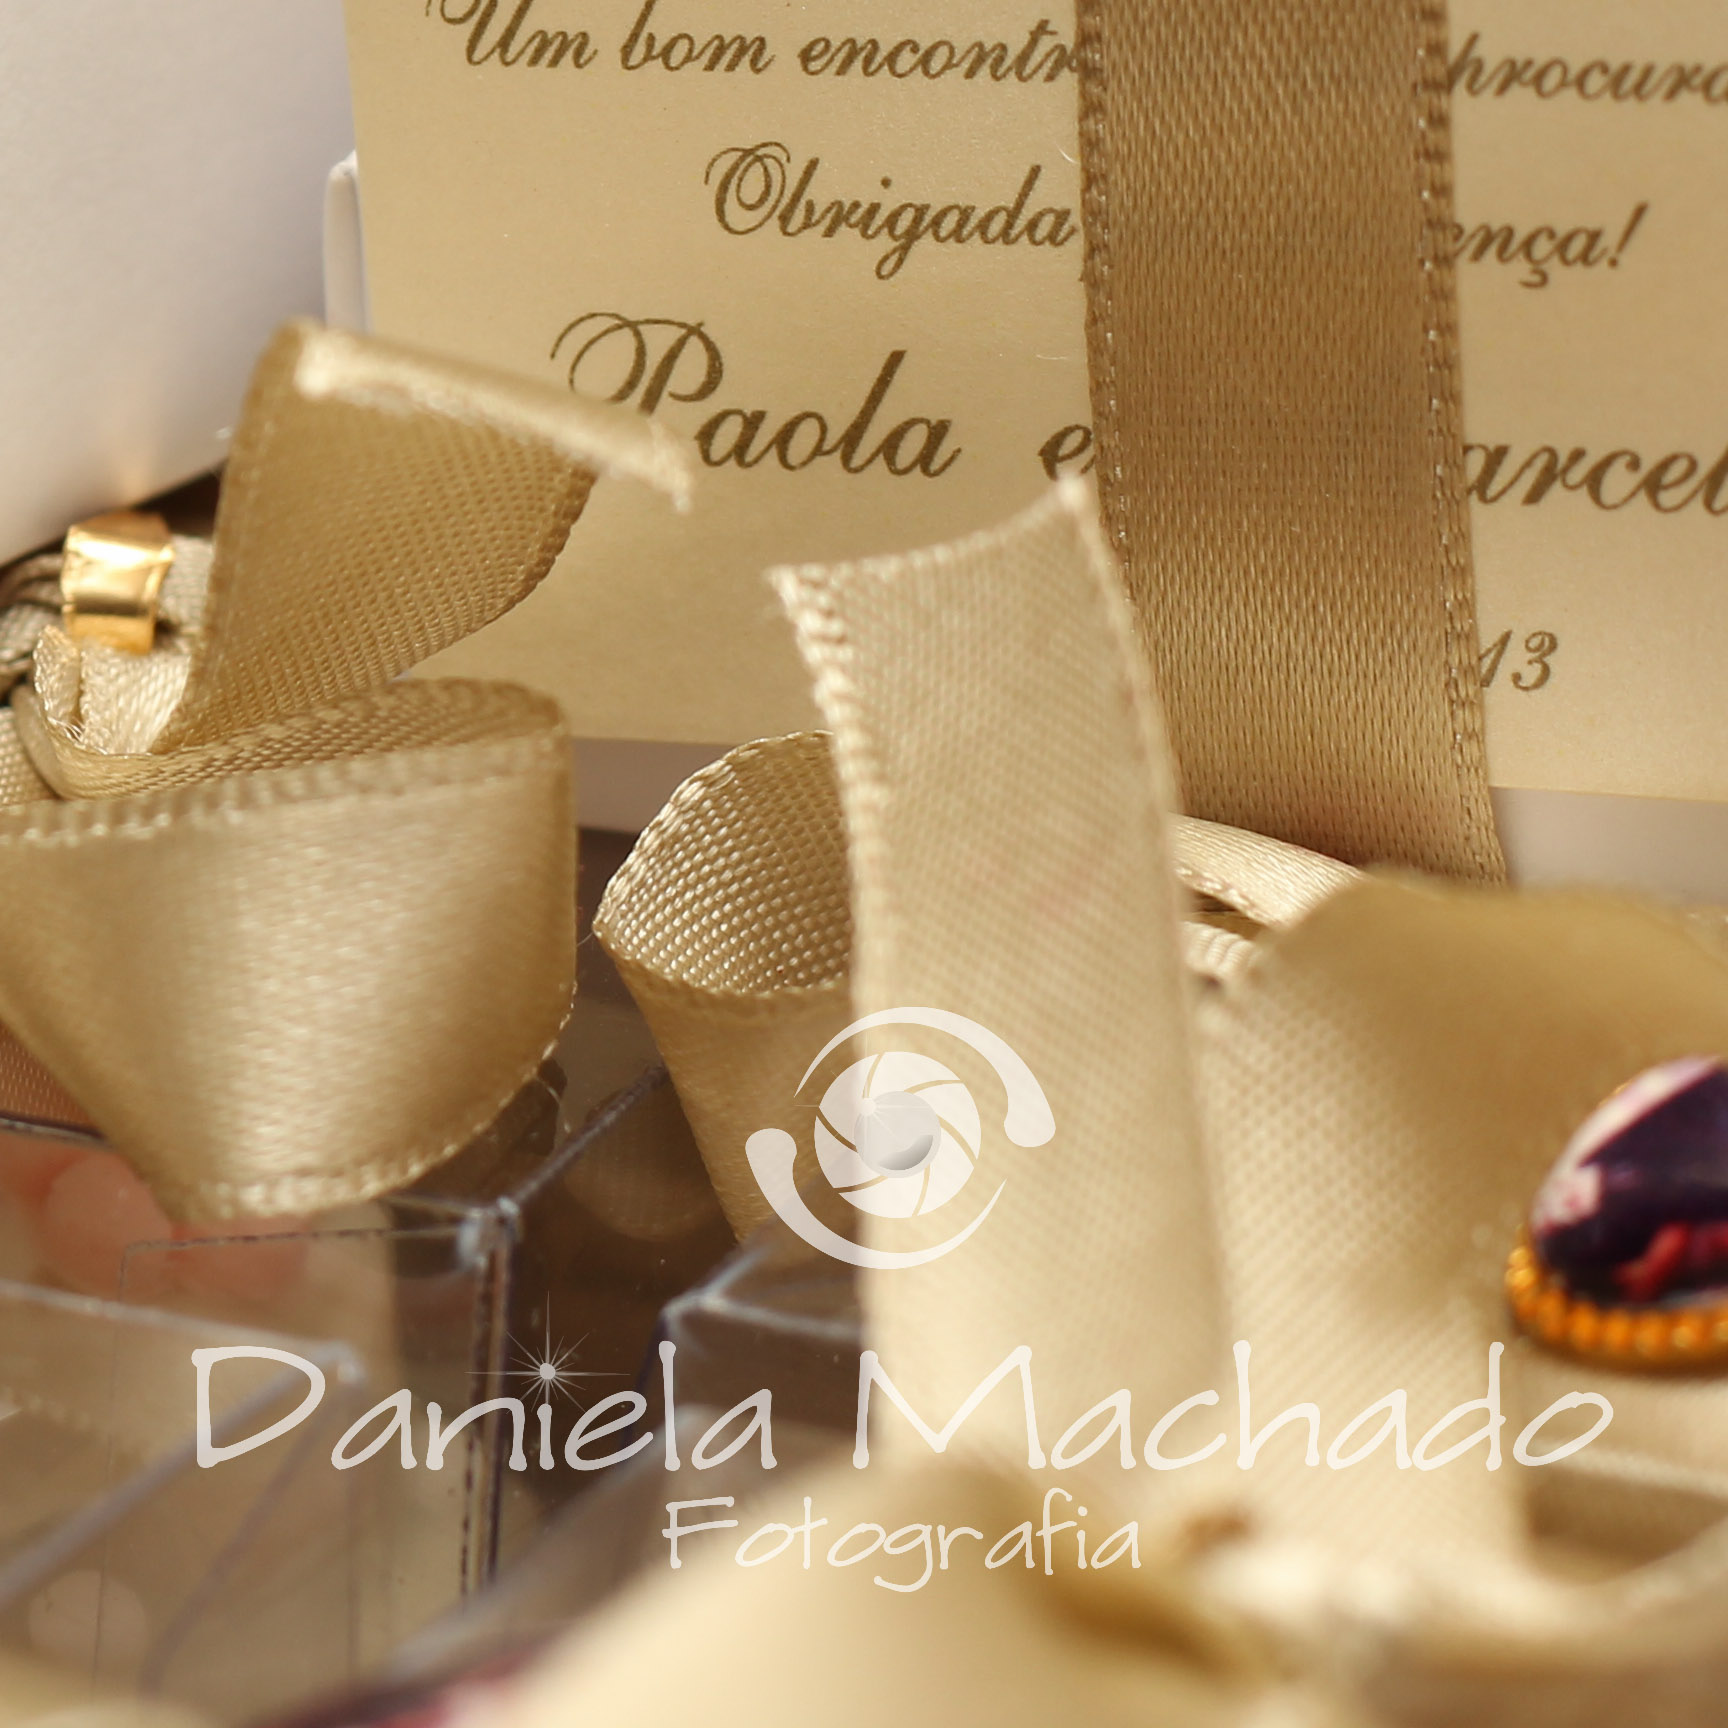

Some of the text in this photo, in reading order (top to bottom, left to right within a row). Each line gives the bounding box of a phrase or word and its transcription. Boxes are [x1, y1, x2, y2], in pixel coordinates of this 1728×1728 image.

[798, 16, 1080, 83] encontr
[704, 141, 1076, 280] Obrigada
[549, 311, 962, 477] Paola
